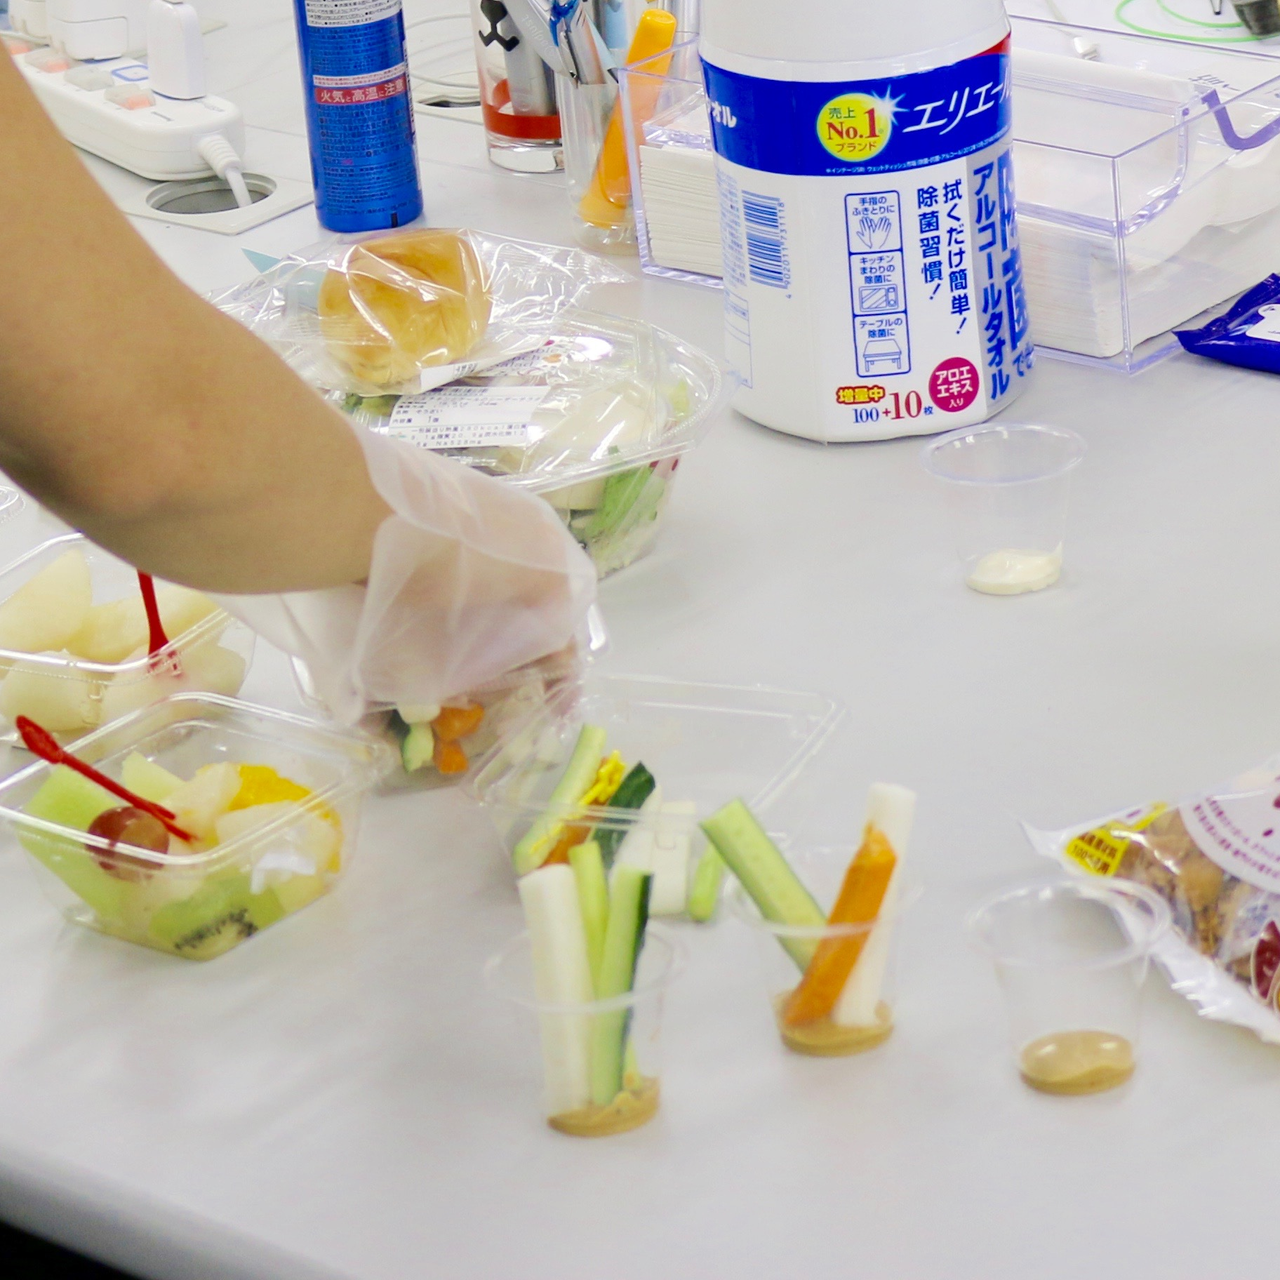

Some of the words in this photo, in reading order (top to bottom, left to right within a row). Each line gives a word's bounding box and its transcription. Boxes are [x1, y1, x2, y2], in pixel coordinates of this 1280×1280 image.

[320, 81, 405, 104] 火気と高温に注意
[828, 107, 856, 119] 売上
[826, 107, 880, 141] No.1
[835, 141, 878, 153] ブランド
[858, 196, 887, 206] 手指の
[852, 205, 895, 216] ふきとりに
[859, 255, 894, 265] キッチン
[859, 264, 895, 275] まわりの
[864, 274, 892, 284] 除菌に
[973, 161, 1010, 401] アルコールタオル
[859, 317, 903, 329] テーブルの
[867, 327, 895, 338] 除菌に
[935, 365, 972, 384] アロエ
[837, 386, 885, 403] 増量中
[936, 379, 973, 398] エキス
[948, 397, 964, 409] 入り
